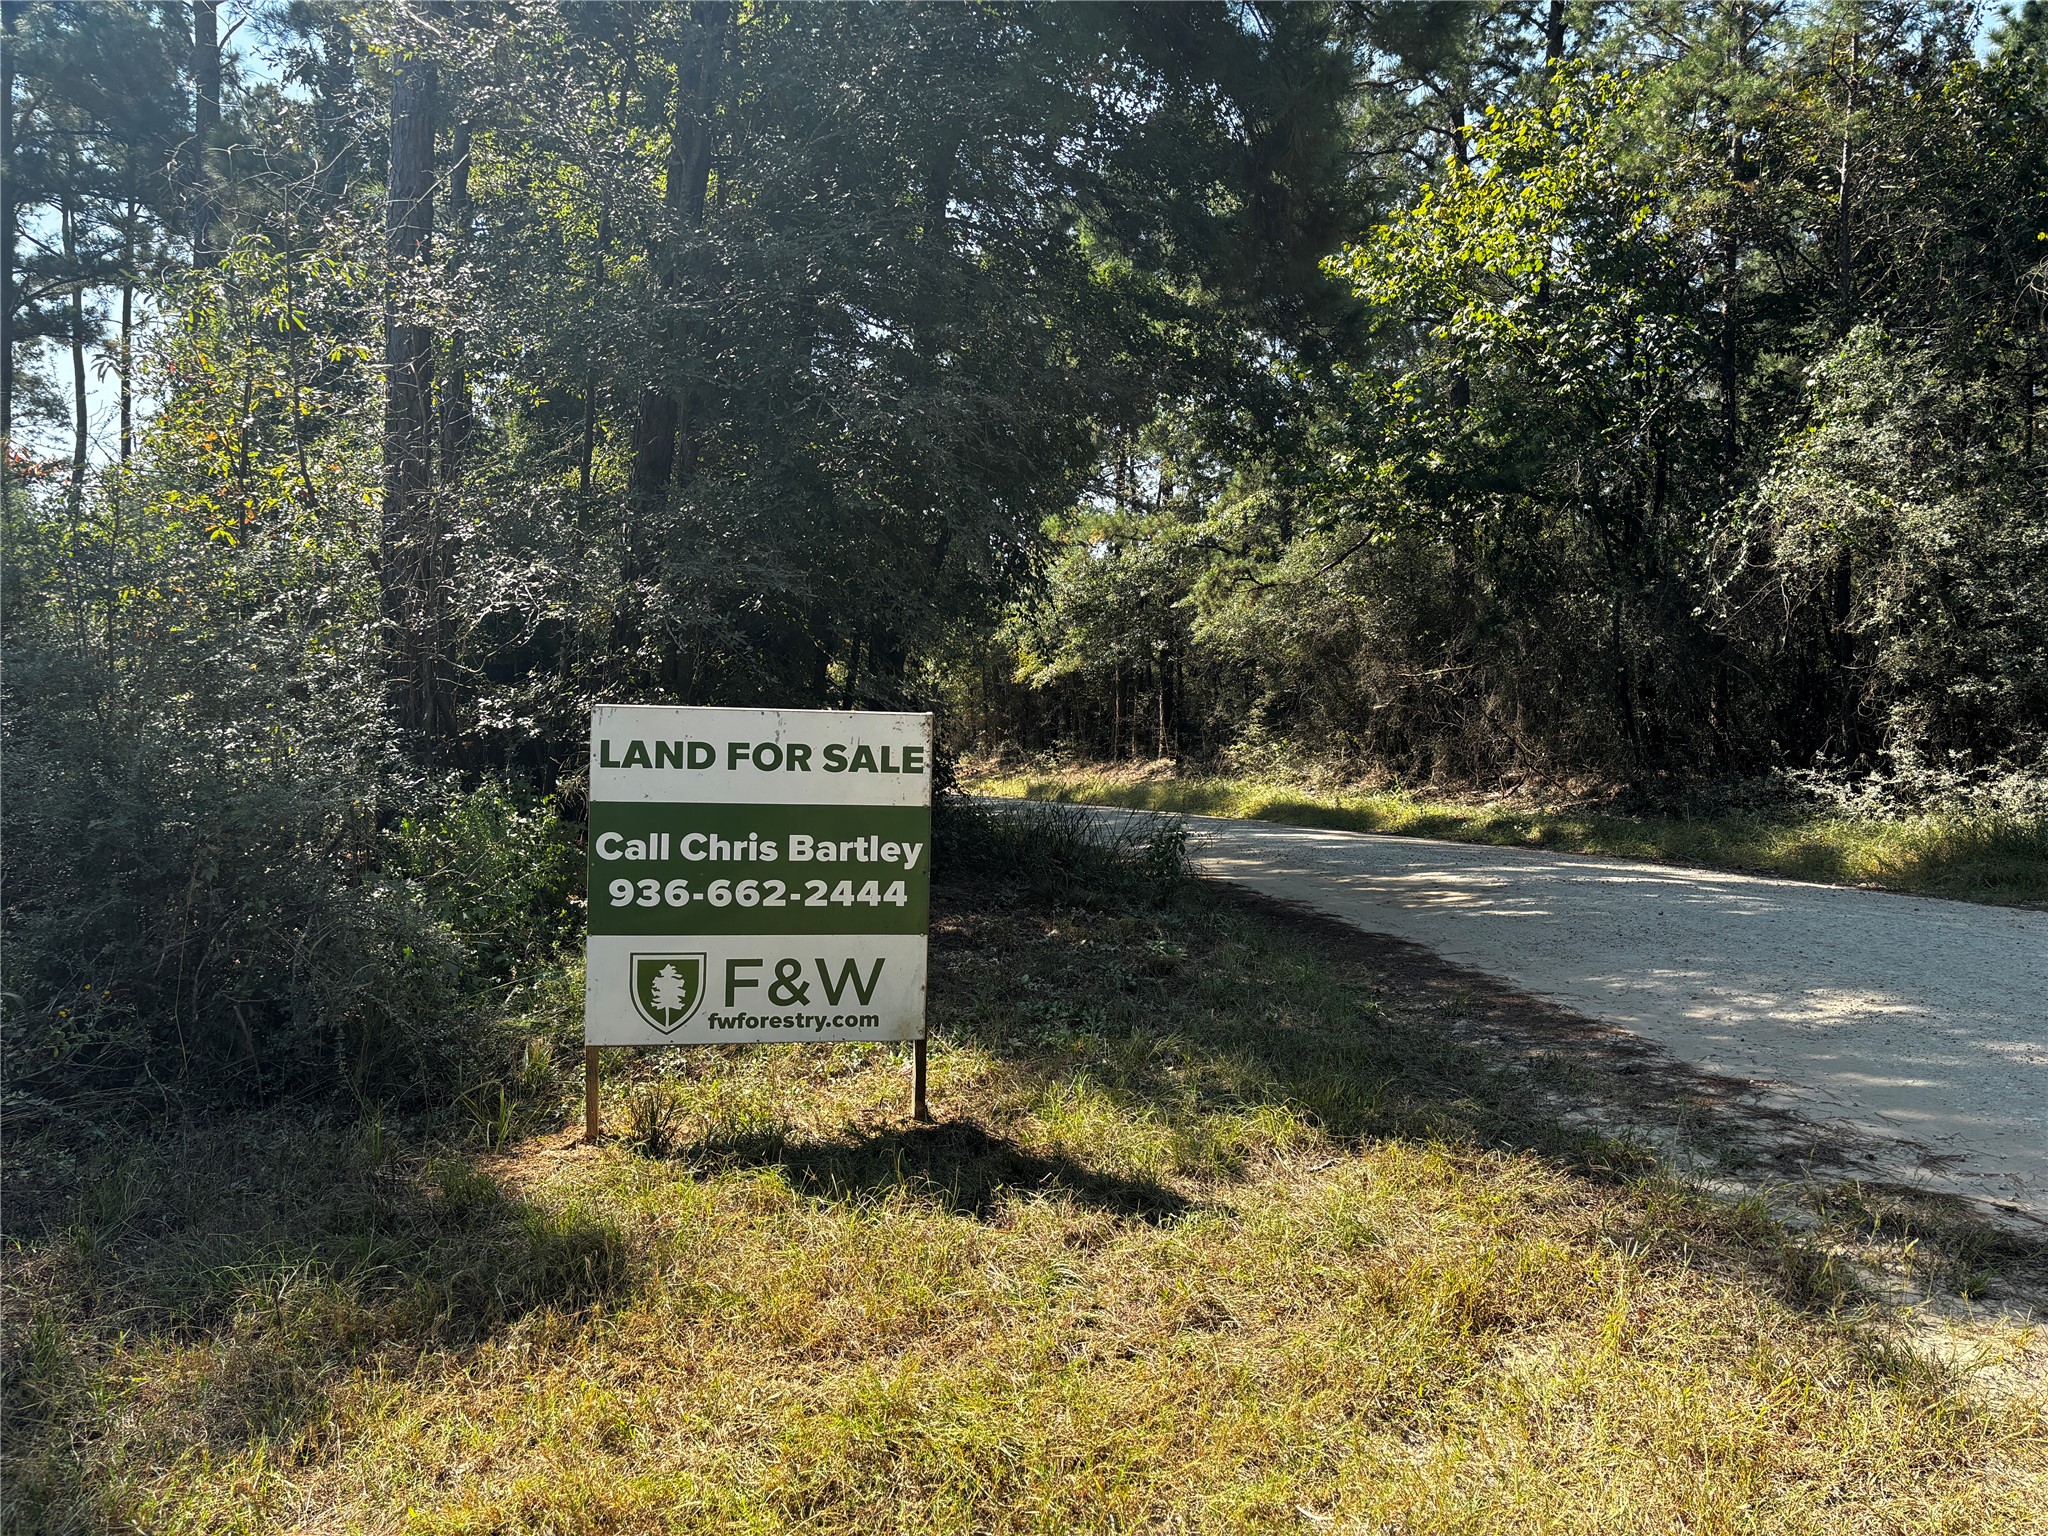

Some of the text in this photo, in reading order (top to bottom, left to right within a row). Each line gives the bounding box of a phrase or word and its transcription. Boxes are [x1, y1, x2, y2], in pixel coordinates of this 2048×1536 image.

[600, 739, 925, 774] LAND FOR SALE
[595, 831, 923, 870] Call Chris Bartley
[608, 878, 908, 908] 936-662-2444
[724, 957, 886, 1008] F&W
[708, 1012, 880, 1033] fwforestry.com
